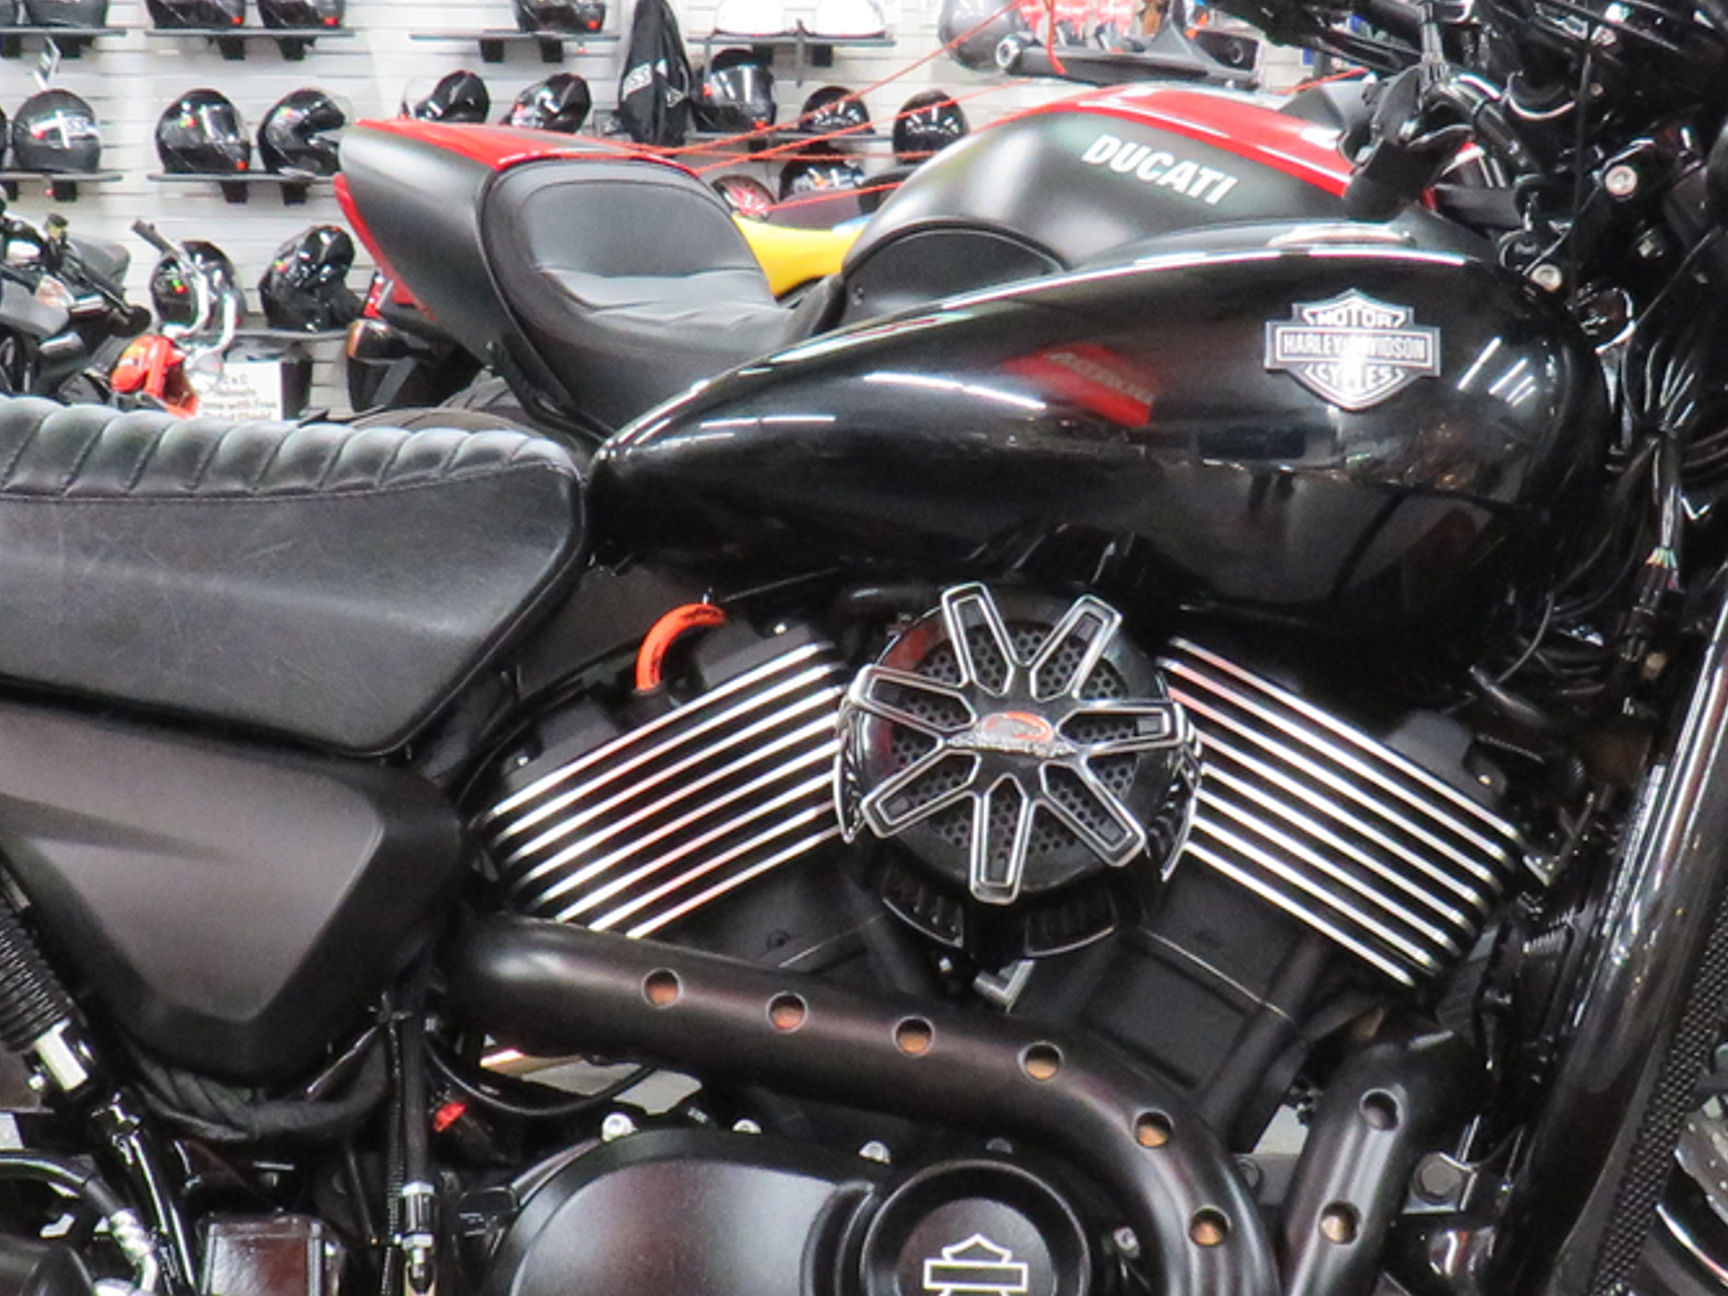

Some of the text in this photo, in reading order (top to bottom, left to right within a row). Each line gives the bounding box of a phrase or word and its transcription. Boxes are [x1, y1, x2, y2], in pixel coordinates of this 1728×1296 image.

[1081, 134, 1238, 204] DUCATI
[1317, 307, 1395, 327] MOTOR
[1315, 365, 1393, 388] CYES
